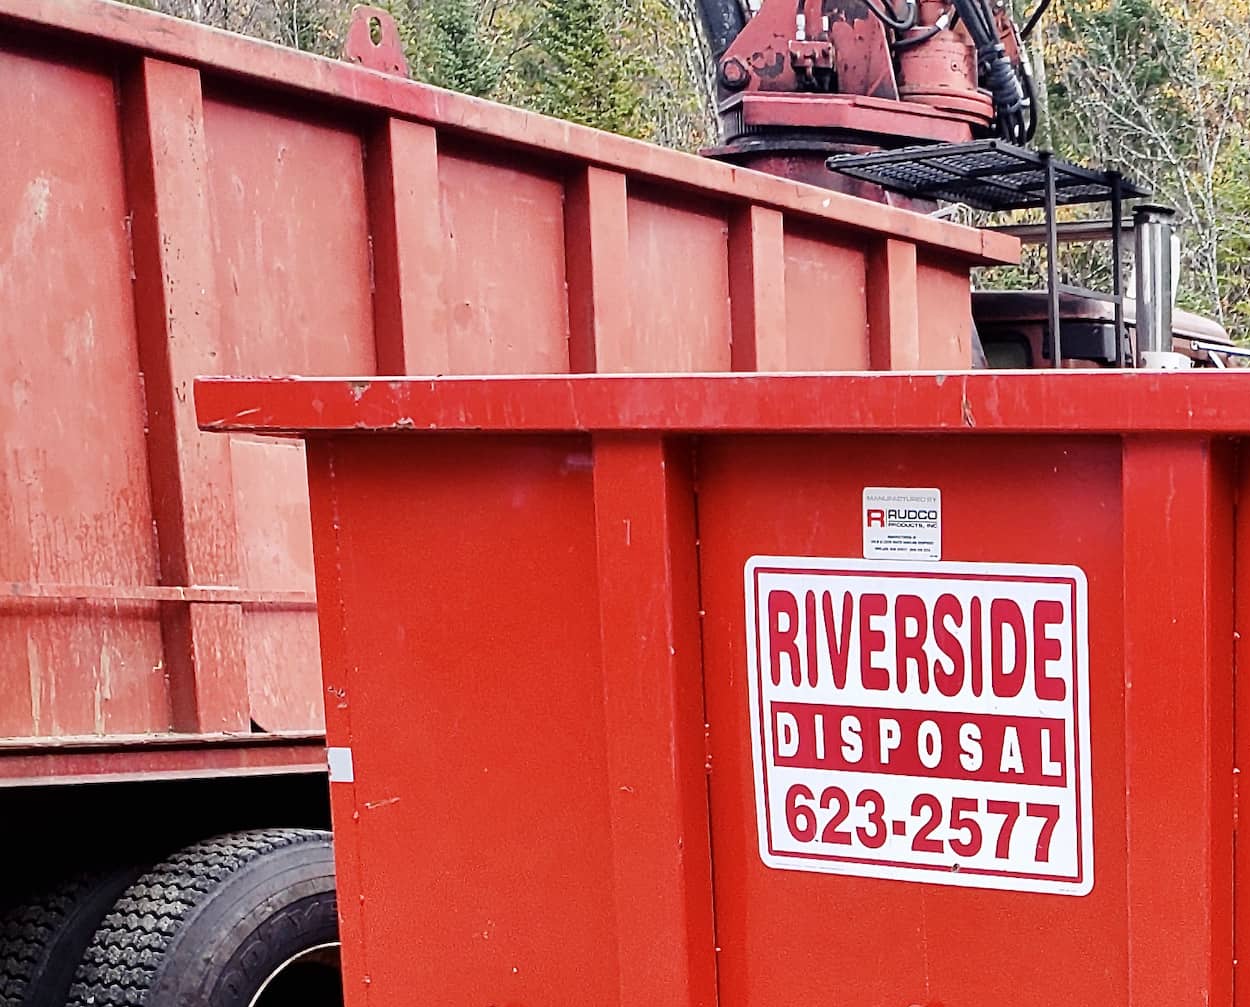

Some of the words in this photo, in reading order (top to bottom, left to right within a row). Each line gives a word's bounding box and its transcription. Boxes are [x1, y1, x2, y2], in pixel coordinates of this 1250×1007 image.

[867, 508, 885, 528] R
[888, 508, 938, 520] RUDCO
[768, 589, 1066, 701] RIVERSIDE
[776, 711, 1062, 777] DISPOSAL
[785, 783, 1061, 863] 623-2577
